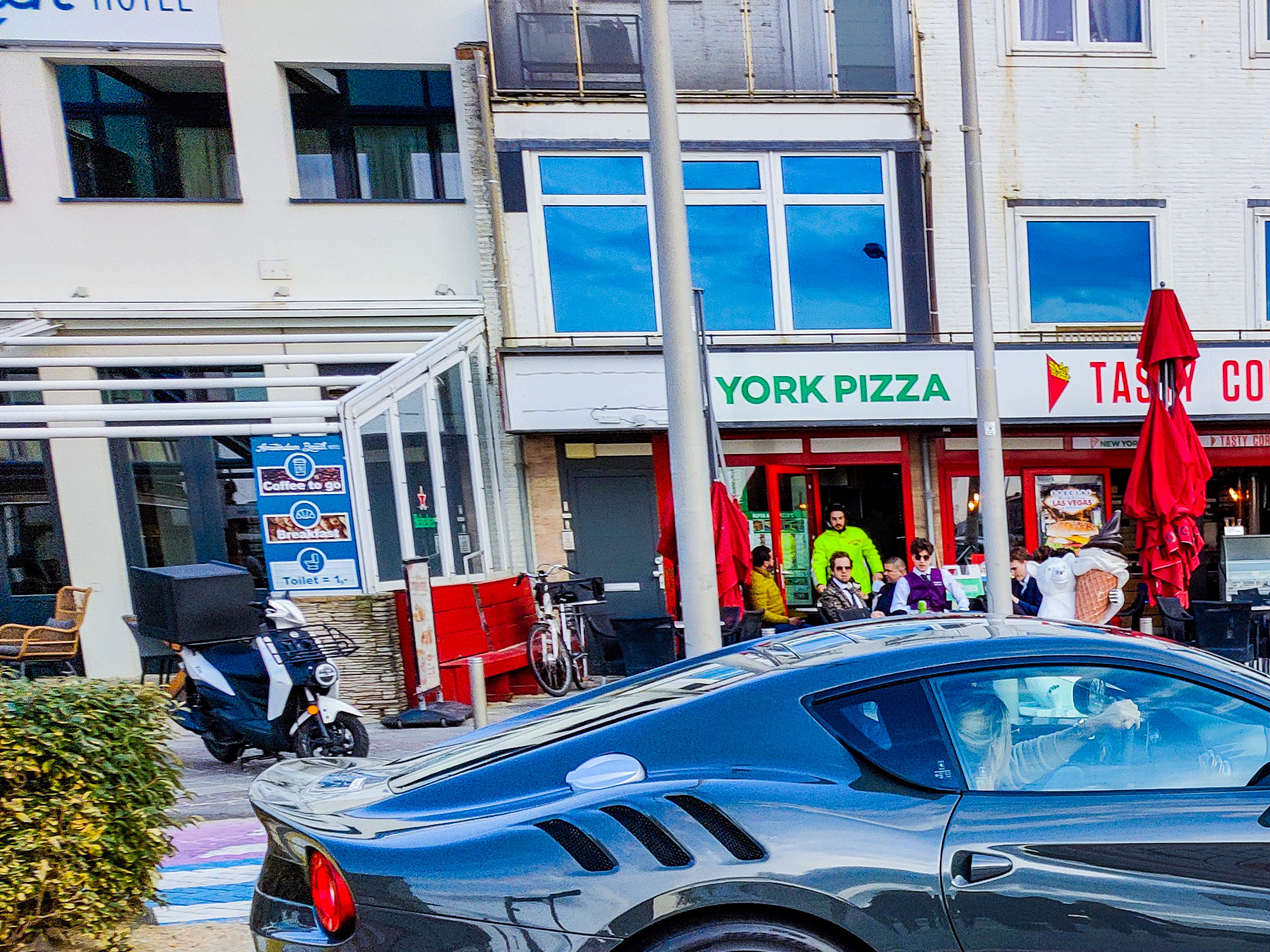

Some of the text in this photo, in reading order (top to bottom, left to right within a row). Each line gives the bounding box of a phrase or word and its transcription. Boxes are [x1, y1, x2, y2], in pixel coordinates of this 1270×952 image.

[1090, 360, 1197, 403] TASY
[715, 374, 951, 405] YORK PIZZA
[1100, 440, 1120, 448] NEW
[1220, 435, 1247, 447] TASTY
[263, 480, 342, 492] Coffee to go
[276, 528, 341, 539] Breakfast
[282, 576, 320, 586] Toilet
